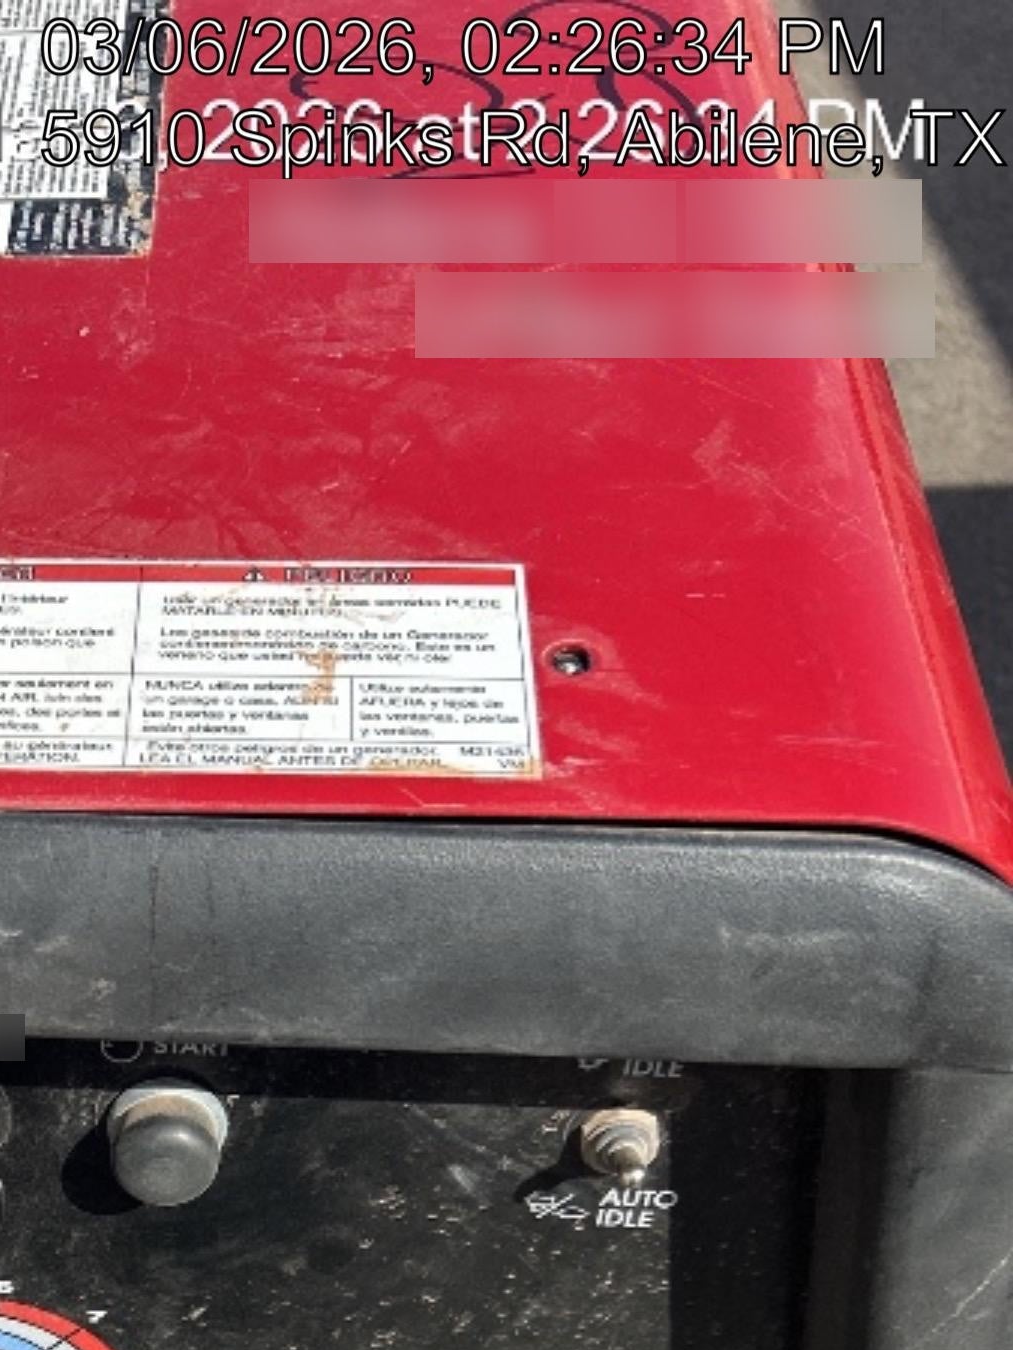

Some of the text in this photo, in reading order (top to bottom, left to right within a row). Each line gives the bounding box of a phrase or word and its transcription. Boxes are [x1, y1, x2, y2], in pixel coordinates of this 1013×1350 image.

[622, 1058, 685, 1078] IDLE
[598, 1189, 678, 1209] AUTO
[595, 1209, 656, 1229] IDLE
[85, 1310, 108, 1325] 7
